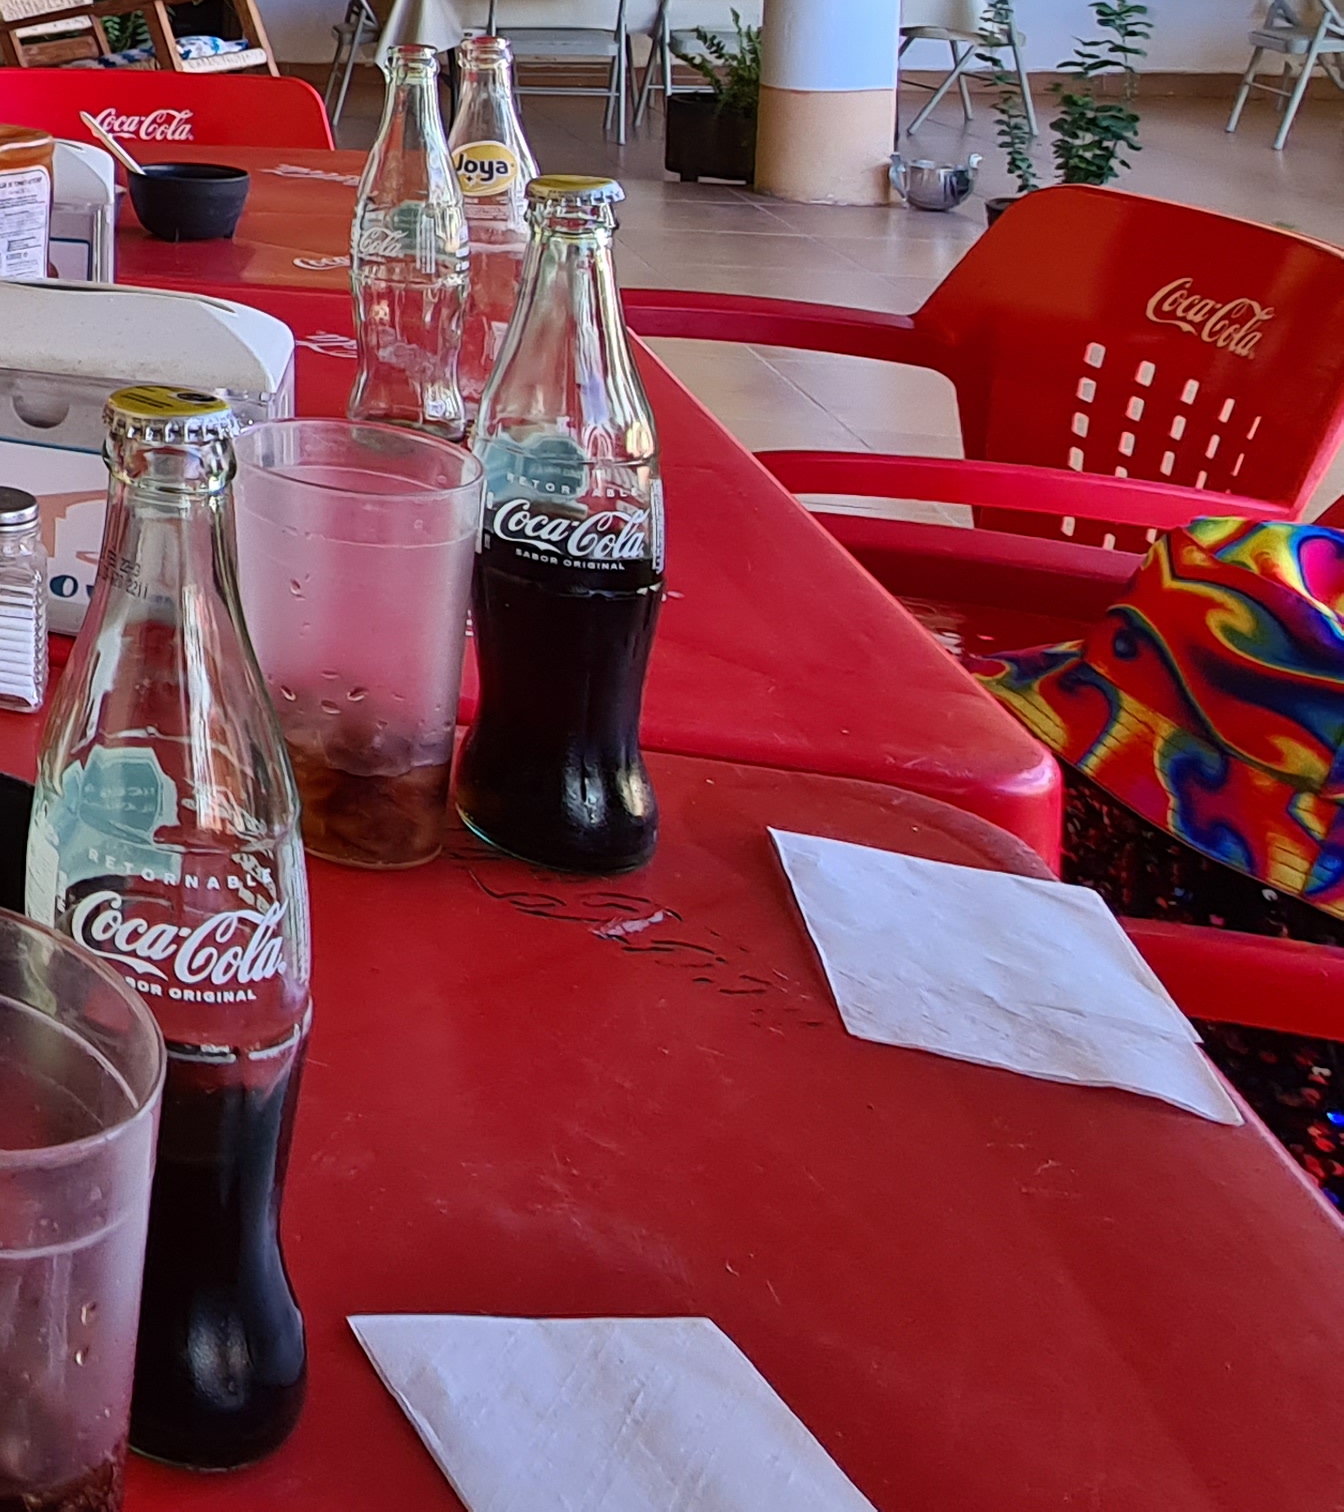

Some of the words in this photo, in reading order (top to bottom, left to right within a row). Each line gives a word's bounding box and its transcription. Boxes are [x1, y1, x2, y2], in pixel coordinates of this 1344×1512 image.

[95, 108, 195, 142] Coca-Cola
[455, 153, 509, 182] Joya
[1145, 277, 1275, 359] Coca-Cola
[494, 498, 650, 559] Coca-Cola
[515, 547, 559, 565] SABOR
[562, 558, 626, 571] ORIGINAL
[87, 847, 273, 890] RETORNABLE
[71, 890, 289, 985] Coca-Cola
[168, 986, 258, 1004] ORIGINAL
